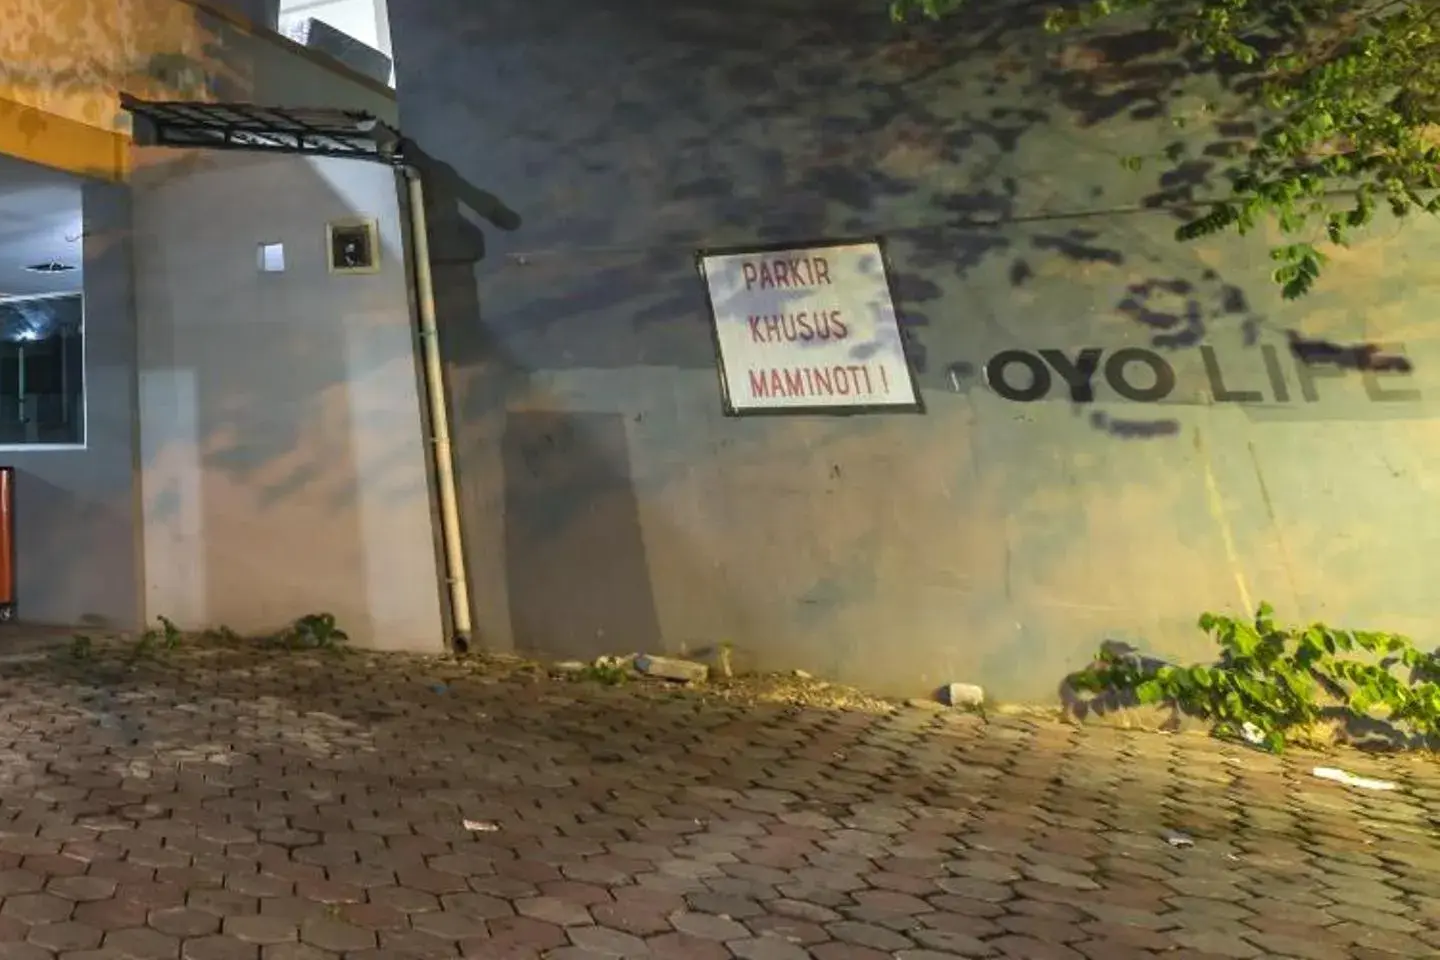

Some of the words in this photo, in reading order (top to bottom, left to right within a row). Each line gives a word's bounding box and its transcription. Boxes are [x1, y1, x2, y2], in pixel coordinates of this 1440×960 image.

[742, 257, 832, 290] PARKIR
[748, 310, 848, 343] KHUSUS
[982, 347, 1177, 403] OYO
[1200, 345, 1421, 403] LIFE
